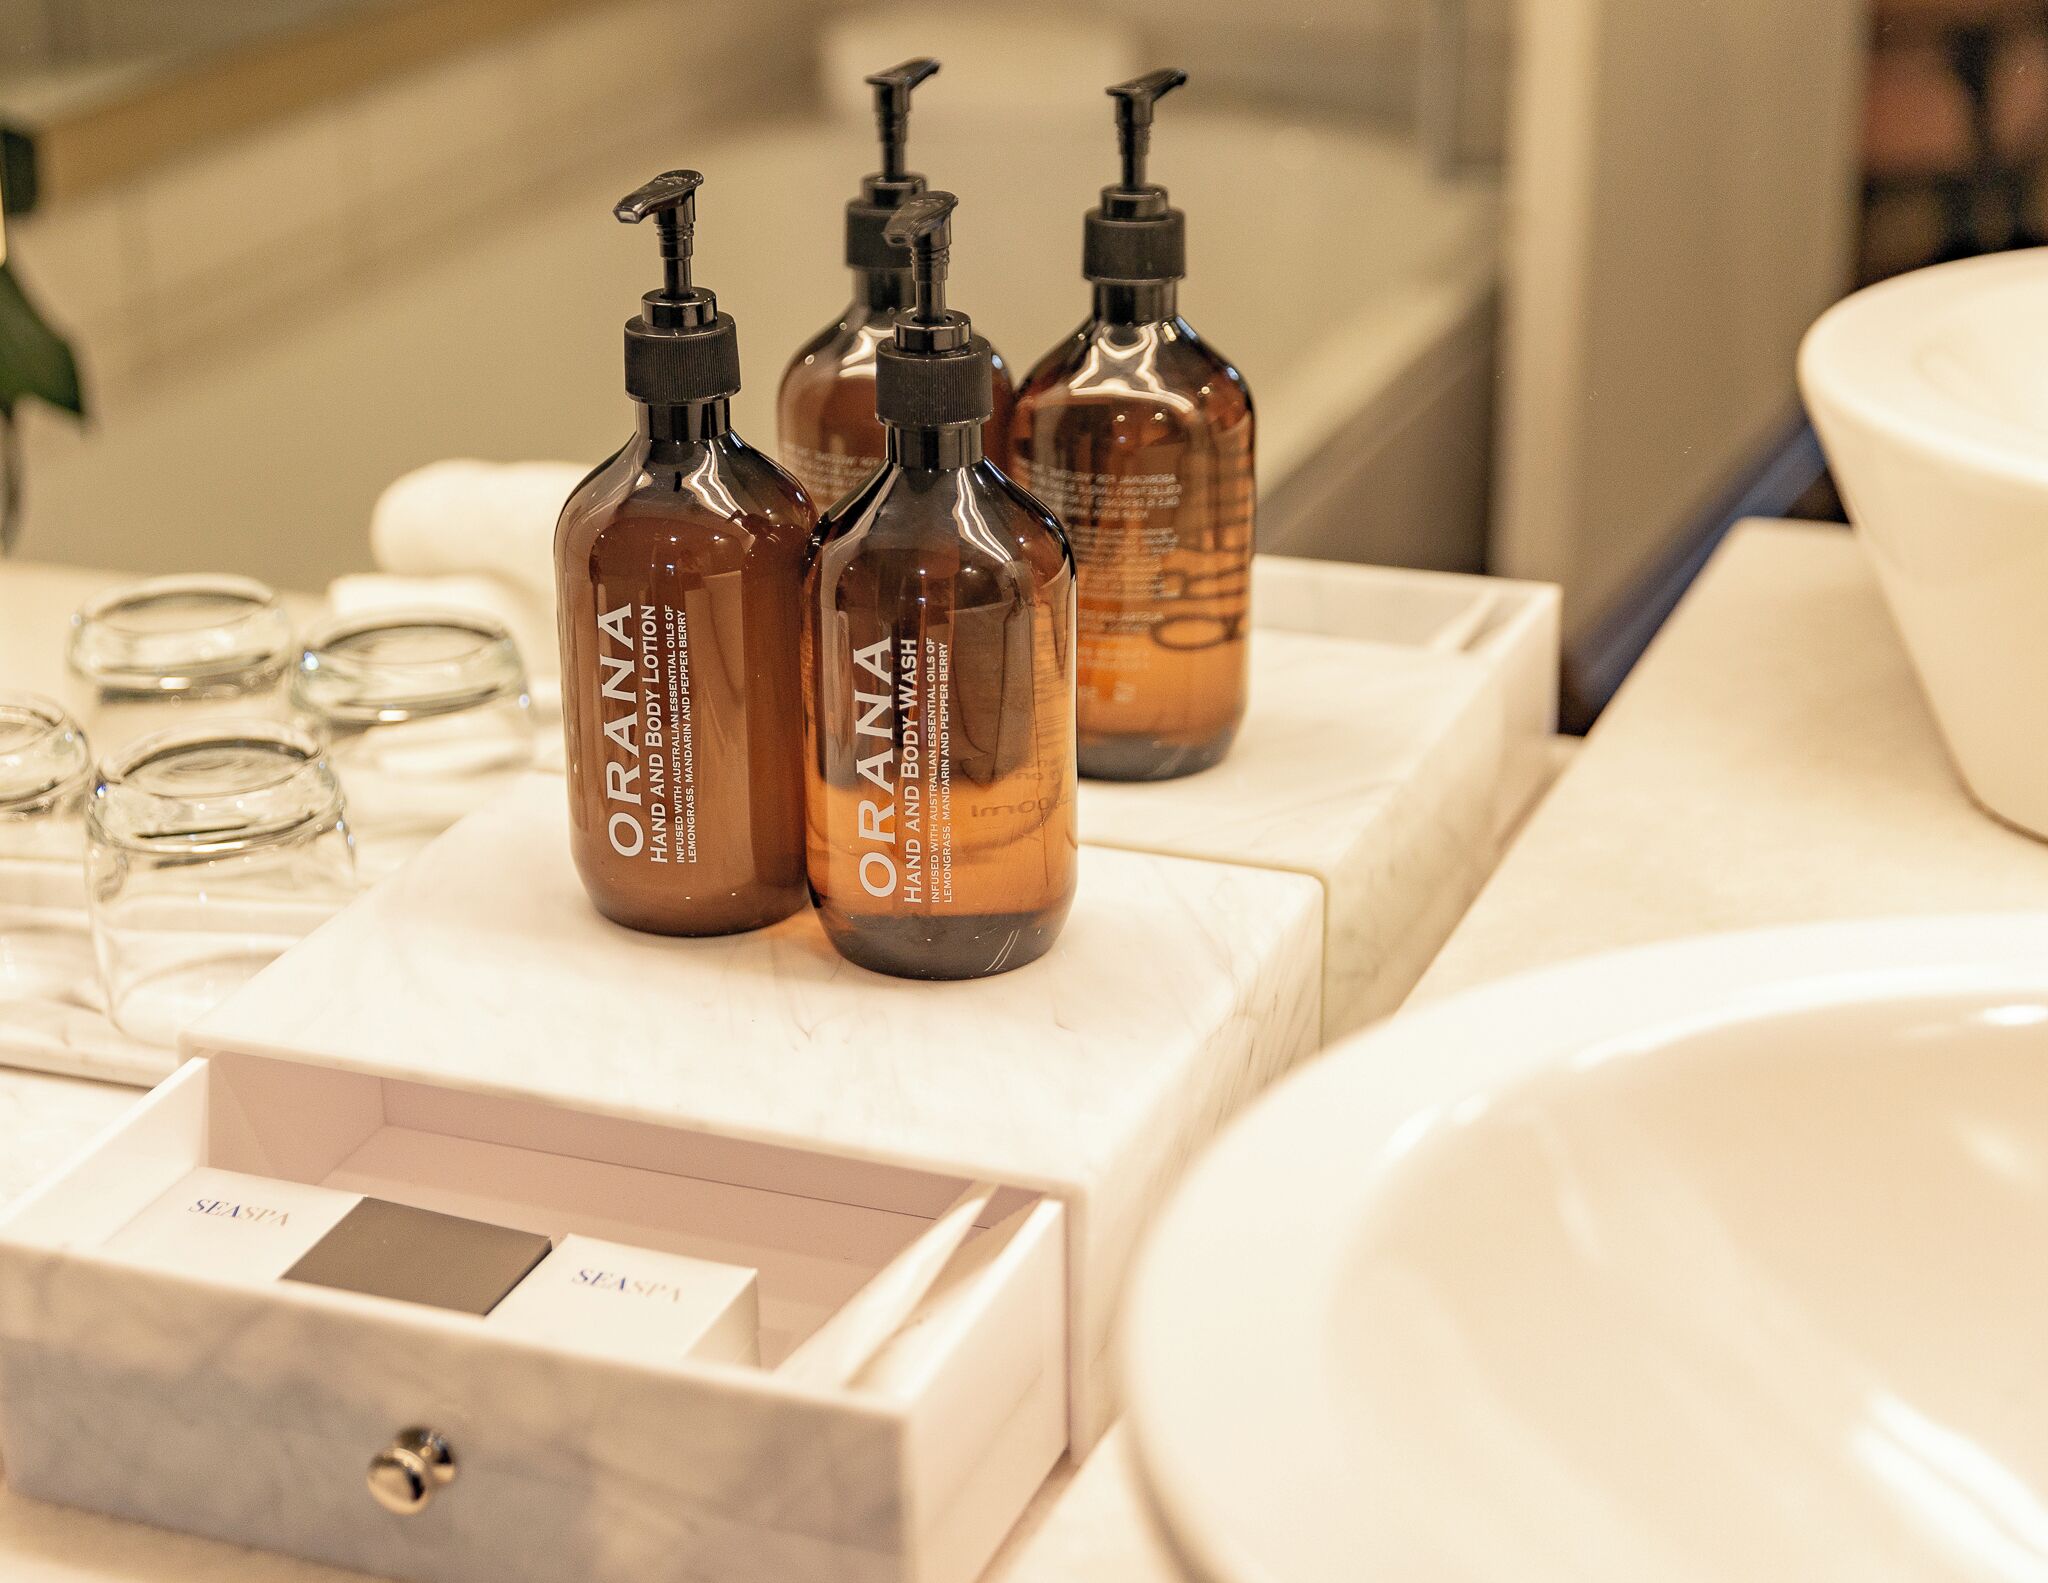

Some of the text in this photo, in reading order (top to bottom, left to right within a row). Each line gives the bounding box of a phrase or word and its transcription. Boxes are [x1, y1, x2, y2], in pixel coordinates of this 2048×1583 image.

[597, 603, 644, 857] ORANA
[640, 605, 668, 863] HAND AND BODY LOTION
[664, 604, 685, 863] INFUSED WITH AUSTRALIAN ESSENTIAL OILS OF
[677, 609, 697, 863] LEMONGRASS, MANDARIN AND PEPPER BERRY
[853, 636, 897, 898] ORANA
[899, 639, 922, 903] HAND AND BODY WASH
[926, 637, 940, 903] INFUSED WITH AUSTRALIAN ESSENTIAL OILS OF
[938, 642, 952, 903] LEMONGRASS, MANDARIN AND PEPPER BERRY
[187, 1198, 290, 1227] SEASPA
